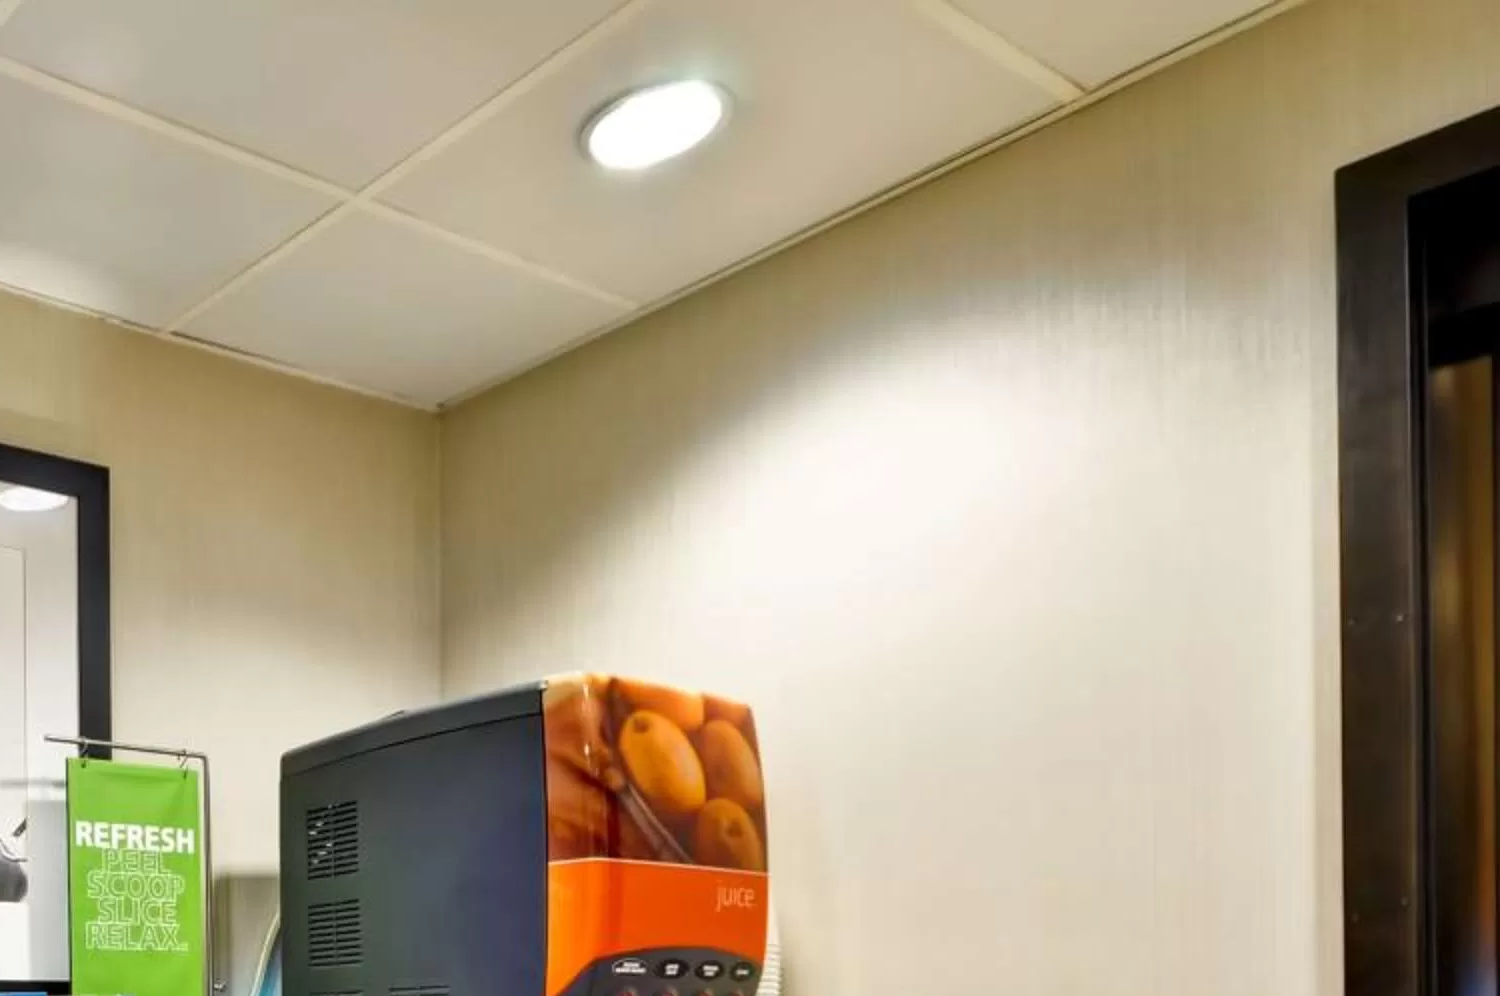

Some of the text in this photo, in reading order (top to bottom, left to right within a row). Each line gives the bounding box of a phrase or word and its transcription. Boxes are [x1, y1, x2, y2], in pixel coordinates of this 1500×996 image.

[75, 820, 196, 855] REFRESH
[102, 848, 171, 876] PEEL
[87, 871, 186, 900] SCOOP
[715, 885, 756, 912] juice
[97, 897, 177, 926] SLICE
